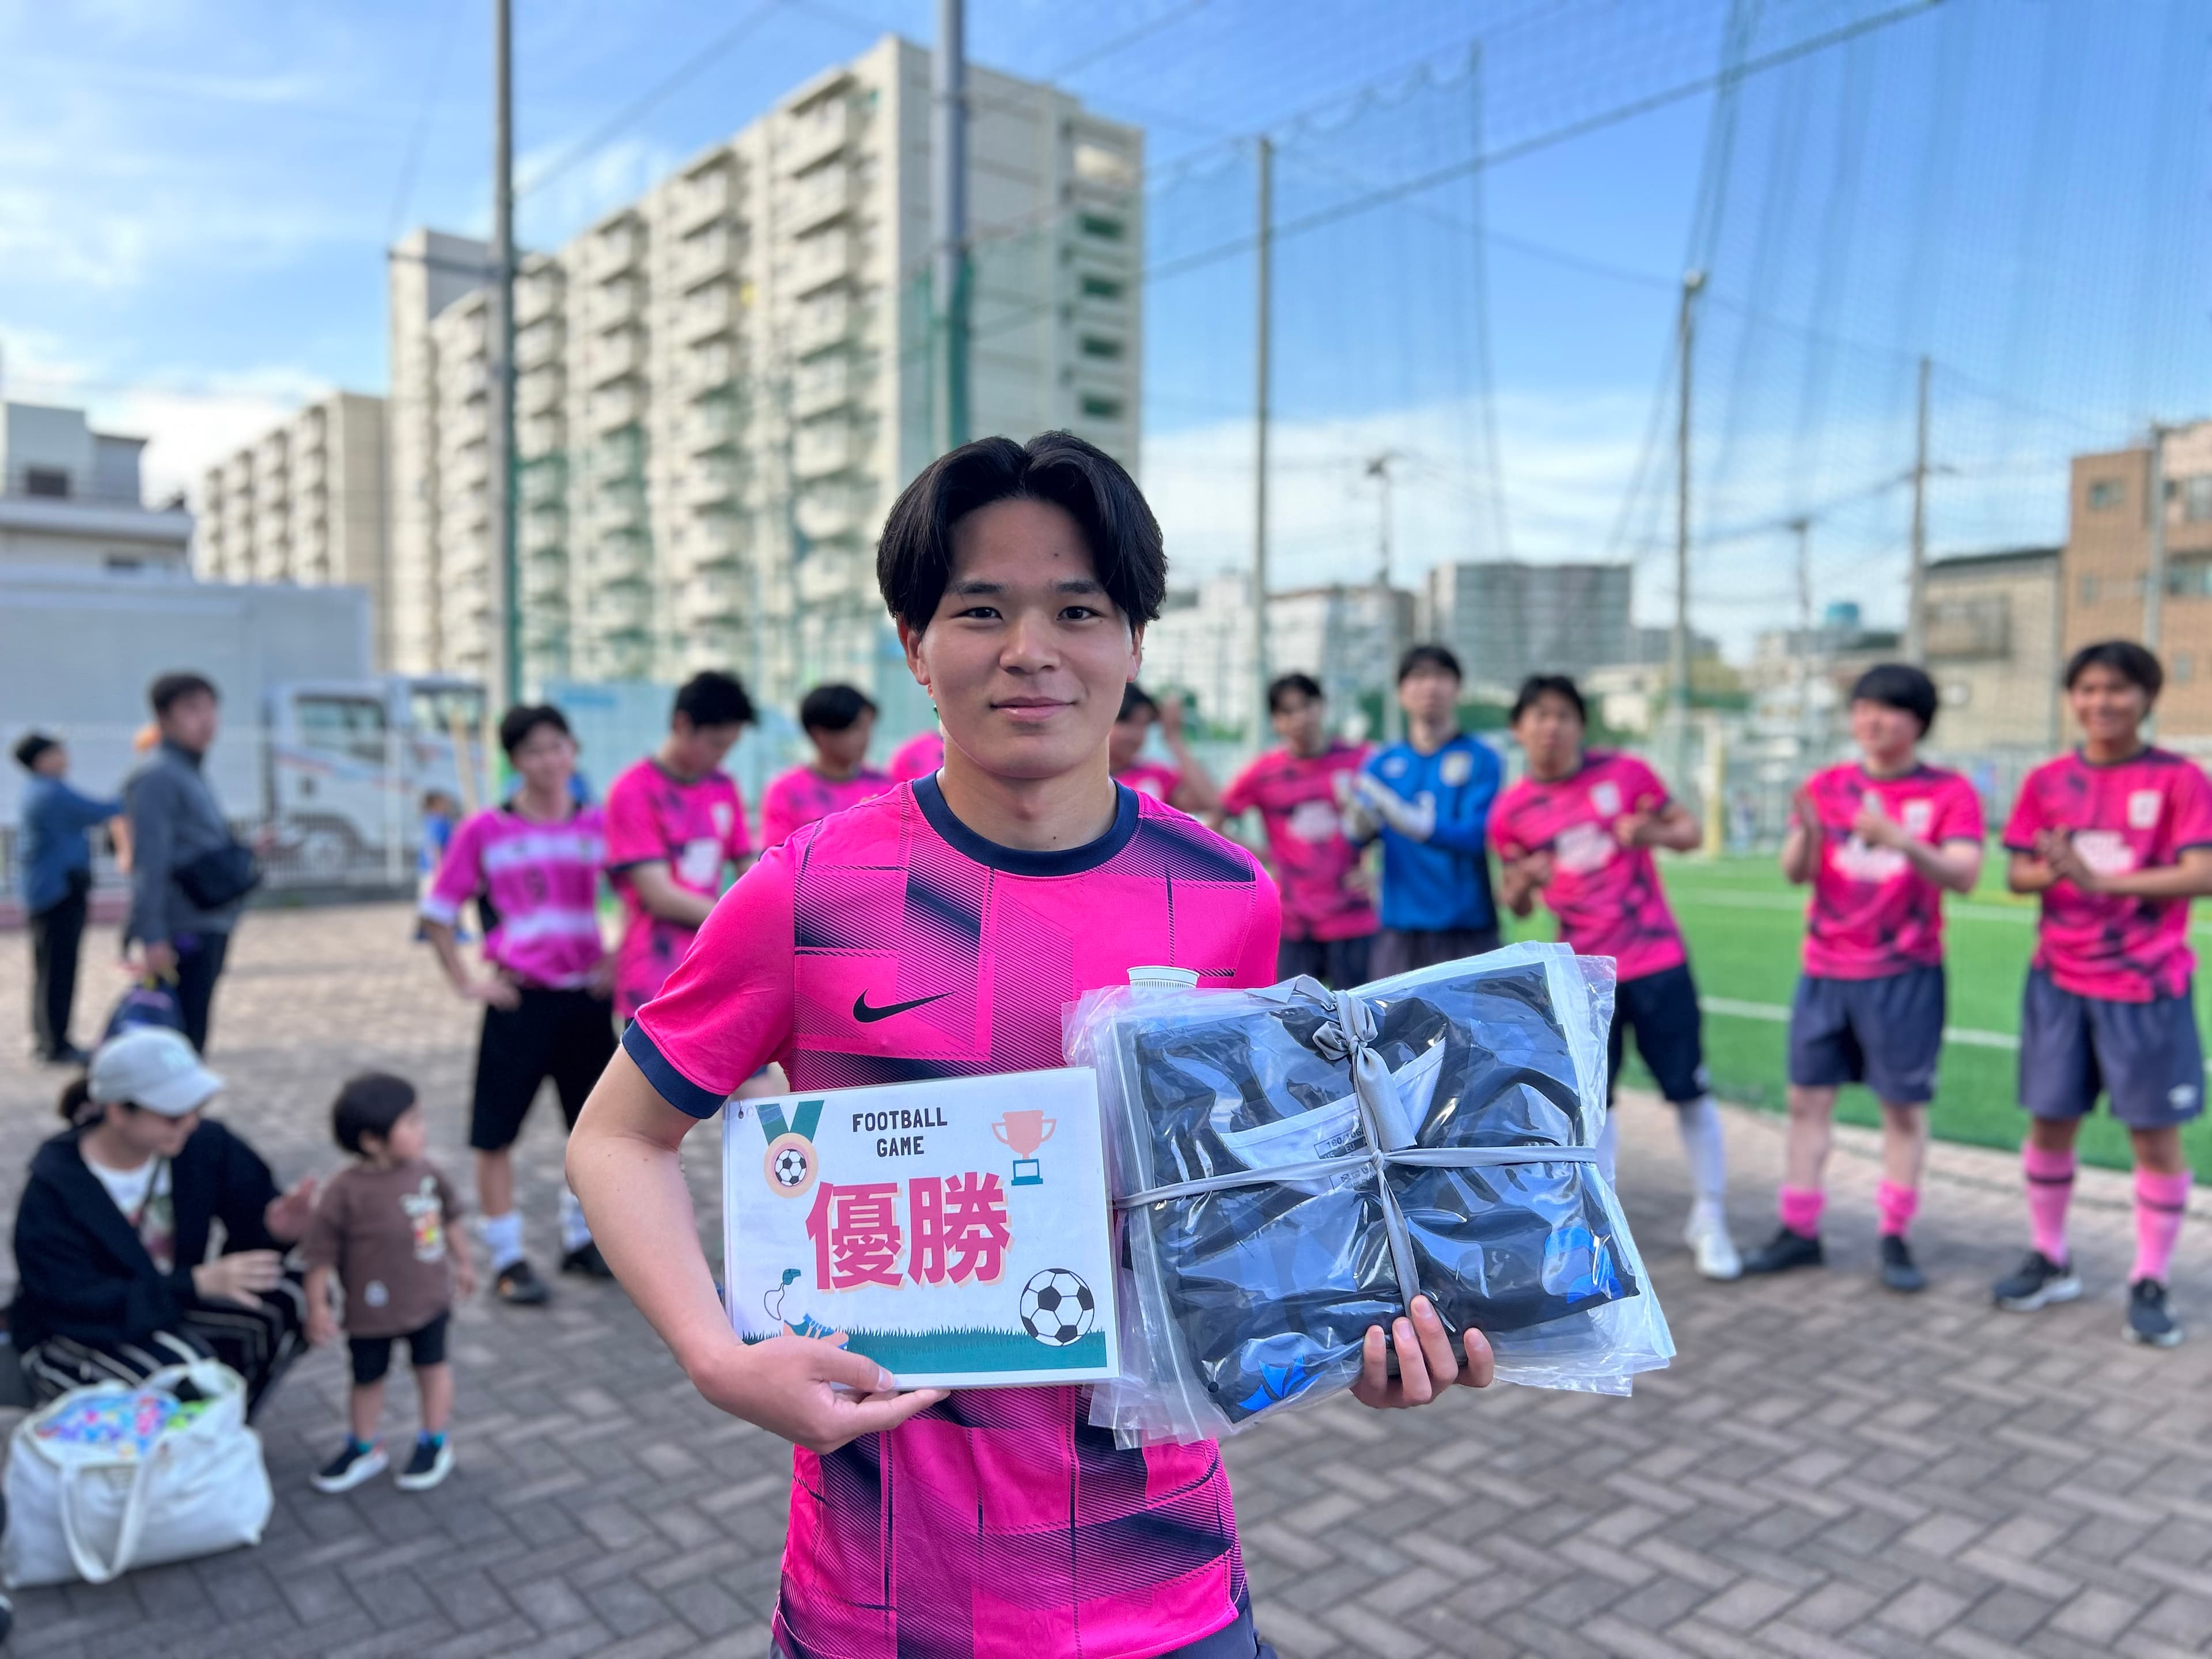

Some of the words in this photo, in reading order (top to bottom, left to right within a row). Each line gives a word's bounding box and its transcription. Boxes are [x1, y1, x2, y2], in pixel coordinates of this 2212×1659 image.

[853, 1107, 948, 1132] FOOTBALL
[876, 1135, 924, 1157] GAME
[1344, 1142, 1355, 1152] EU
[806, 1172, 1013, 1292] 優勝
